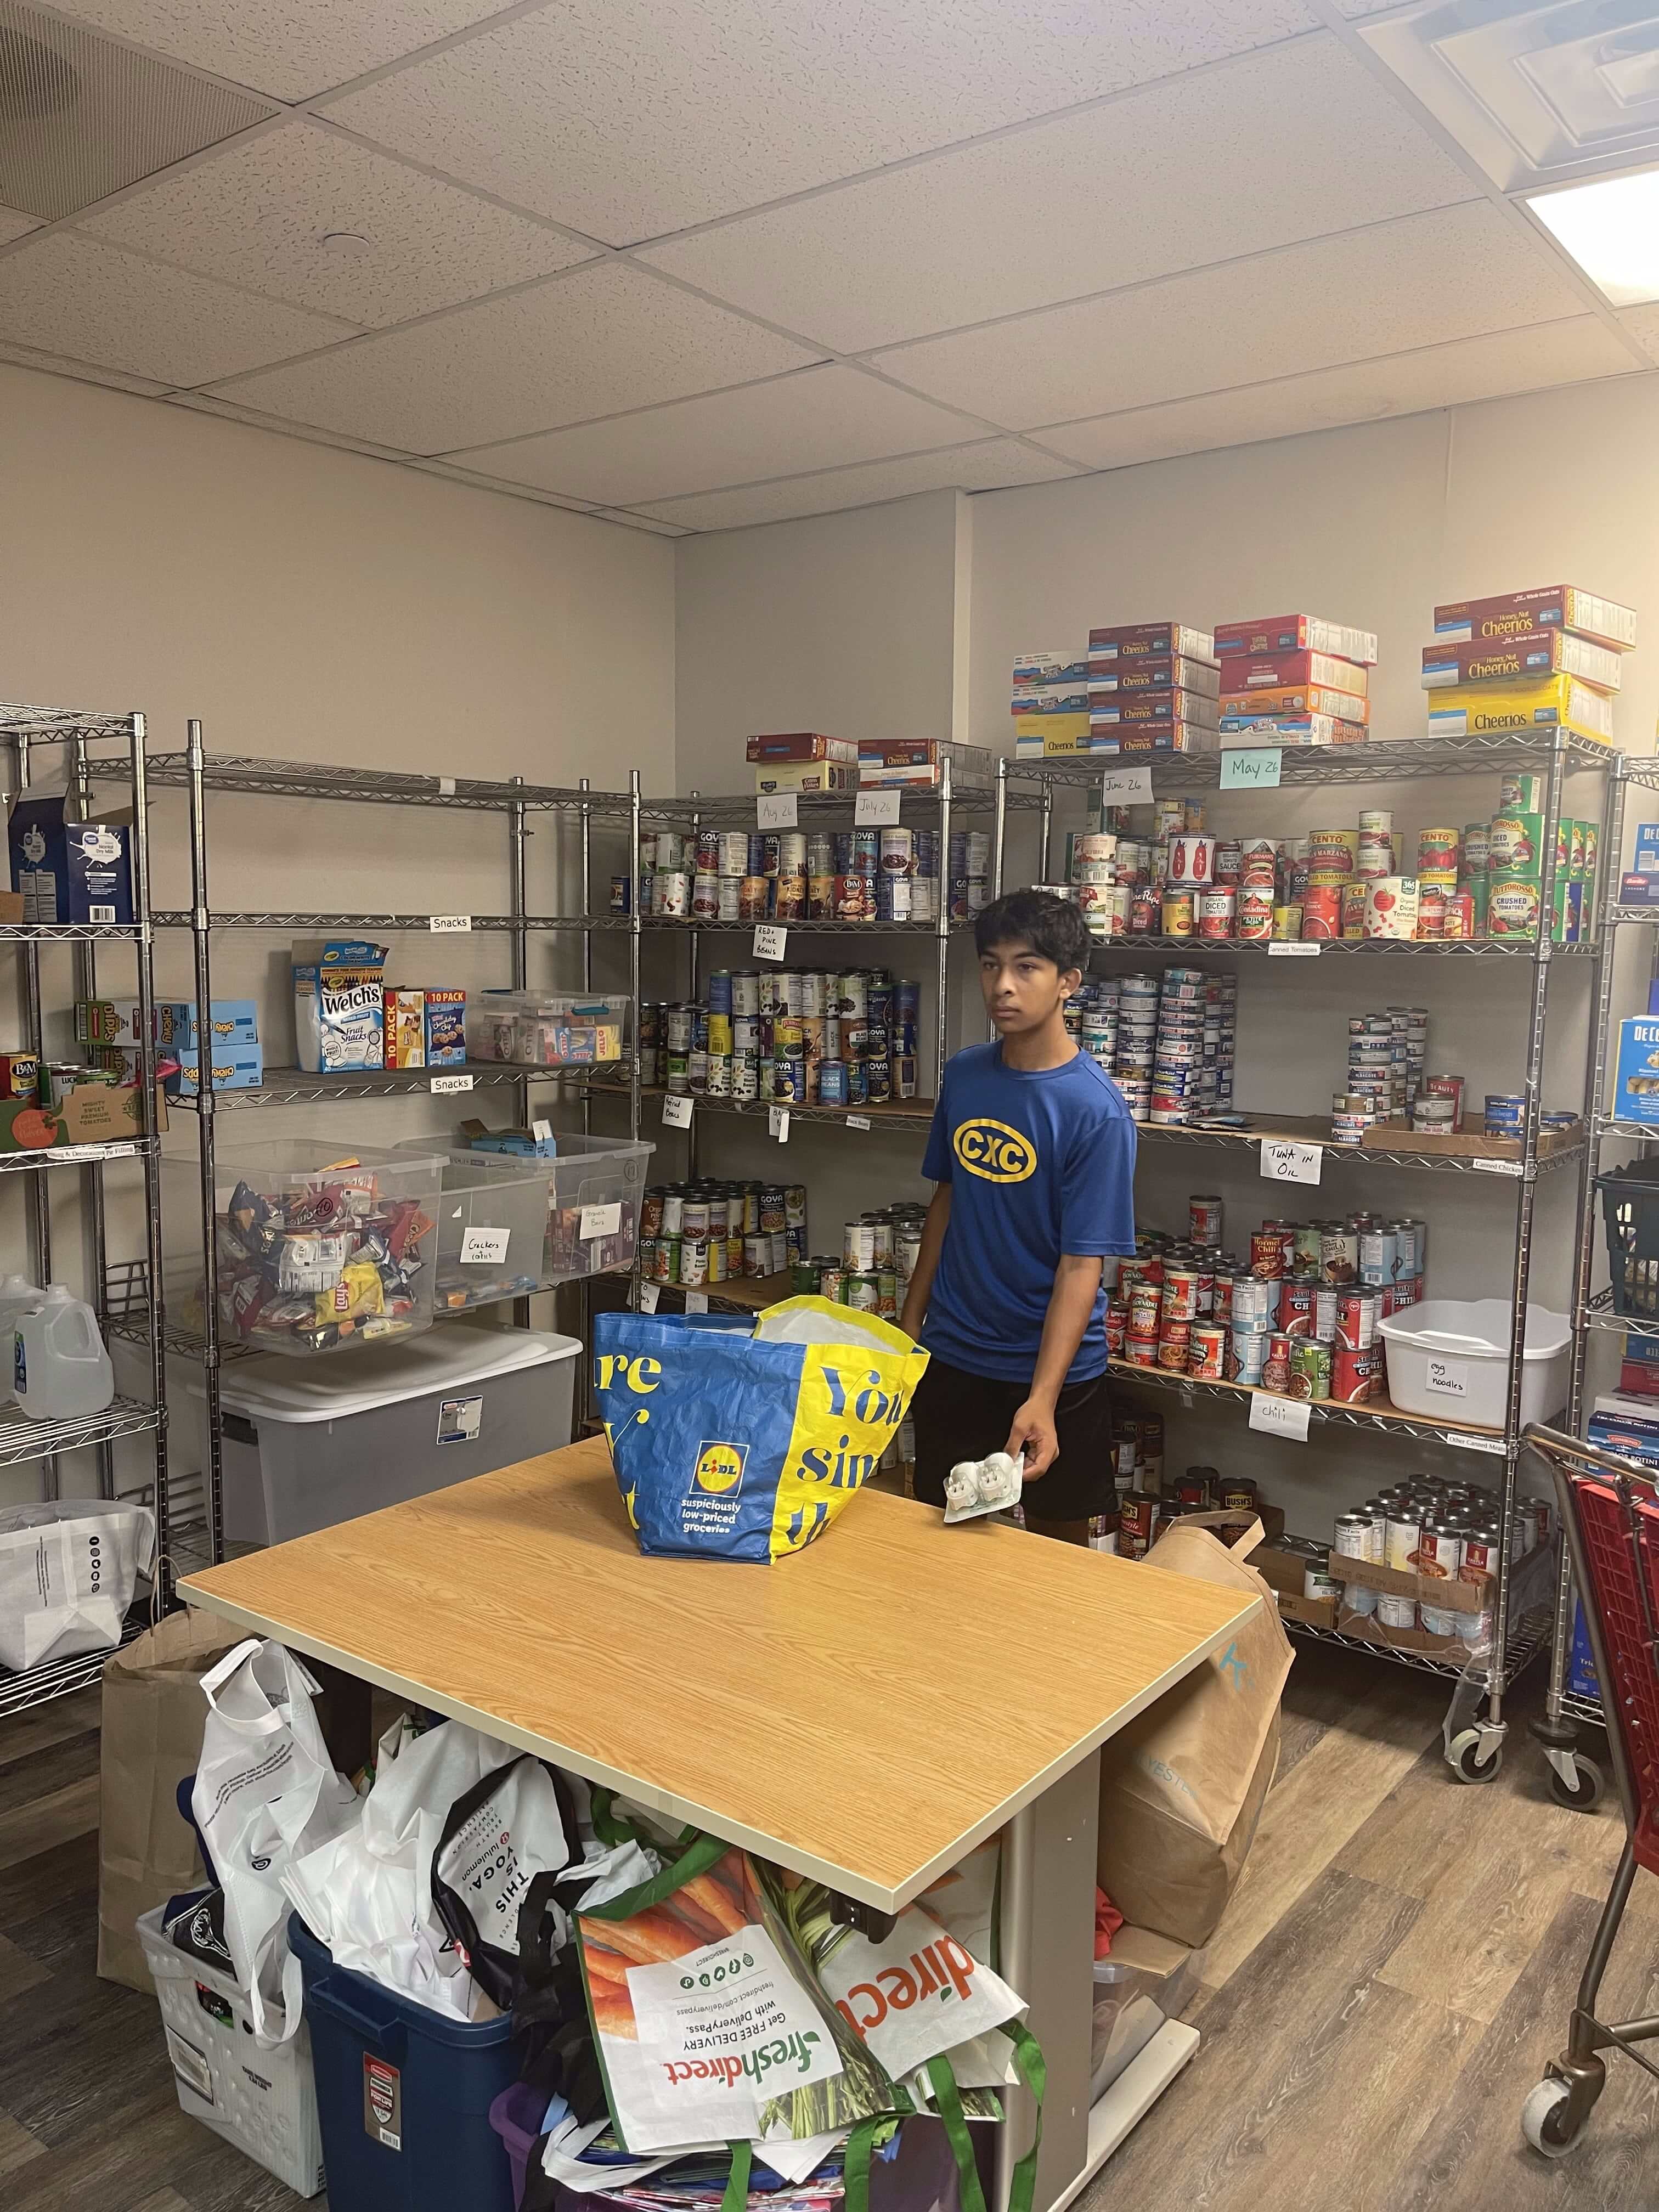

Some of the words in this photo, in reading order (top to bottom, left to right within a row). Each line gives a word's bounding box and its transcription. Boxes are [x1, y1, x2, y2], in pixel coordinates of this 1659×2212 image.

[1499, 612, 1516, 622] Honey
[1517, 610, 1529, 619] Nut
[1481, 618, 1533, 637] Cheerios
[1122, 645, 1149, 655] Cheerios
[1486, 655, 1503, 664] Honey
[1505, 653, 1516, 662] Nut
[1469, 660, 1520, 679] Cheerios
[1123, 676, 1150, 687] Cheerios
[1125, 708, 1152, 719] Cheerios
[1475, 713, 1526, 730] Cheerios
[1048, 741, 1074, 751] Cheerios
[1124, 740, 1152, 751] Cheerios
[887, 757, 910, 765] Cheerios
[1233, 759, 1260, 779] May
[1265, 761, 1278, 772] 26
[1128, 780, 1142, 791] 26
[763, 803, 777, 822] Aug
[859, 798, 878, 816] July
[879, 802, 890, 812] 26
[701, 833, 720, 842] GOY
[1312, 835, 1343, 844] CENTO
[846, 879, 861, 888] B&M
[1403, 881, 1415, 889] 365
[1493, 883, 1533, 894] TUTTOROSSO
[1143, 890, 1160, 905] Ripe
[1239, 905, 1268, 914] Contadina
[1446, 908, 1463, 917] PACK
[434, 918, 467, 929] Snacks
[325, 986, 380, 1014] Welch's
[431, 992, 442, 1002] 10
[443, 991, 463, 1002] PACK
[386, 1005, 396, 1042] PACK
[346, 1025, 363, 1035] Fruit
[341, 1032, 366, 1043] Snacks
[388, 1047, 396, 1058] 10
[16, 1063, 36, 1075] B&M
[775, 1062, 791, 1070] OYA
[869, 1062, 888, 1070] OYA
[435, 1079, 468, 1090] Snacks
[1430, 1082, 1454, 1093] BEAUTY
[962, 1129, 1024, 1173] CXC
[1268, 1144, 1296, 1160] TUNA
[1302, 1154, 1314, 1164] IN
[1277, 1163, 1299, 1178] OIL
[1476, 1161, 1498, 1170] Canned
[1498, 1164, 1523, 1174] Chicken
[760, 1194, 783, 1204] GOYA
[469, 1239, 500, 1250] Crackers
[1255, 1238, 1280, 1246] Hormel
[1431, 1361, 1445, 1374] egg
[595, 1355, 662, 1393] re
[1432, 1376, 1464, 1391] noodles
[1449, 1435, 1466, 1444] Other
[1468, 1438, 1488, 1448] Canned
[1488, 1443, 1506, 1453] Meats
[1610, 1436, 1639, 1446] COMBINO
[1631, 1455, 1658, 1466] ROTINI
[681, 1498, 741, 1513] suspiciously
[1226, 1497, 1252, 1506] BUSH'S
[682, 1510, 736, 1524] low-priced
[682, 1522, 731, 1534] groceries
[458, 1799, 489, 1838] PATIENCE
[477, 1813, 499, 1837] TRUST
[476, 1818, 503, 1848] BREATH
[461, 1842, 500, 1881] lululemon
[506, 1856, 518, 1876] IS
[469, 1846, 514, 1891] YOGA.
[495, 1871, 529, 1914] THIS
[499, 1908, 519, 1939] OLENCE
[676, 1981, 774, 2016] freshdirect.com/deliverypass
[755, 2000, 776, 2016] with
[686, 2011, 753, 2033] DeliveryPass.
[769, 2012, 786, 2023] Get
[741, 2020, 766, 2041] FREE
[683, 2032, 738, 2051] DELIVERY
[663, 2030, 813, 2088] freshdirect
